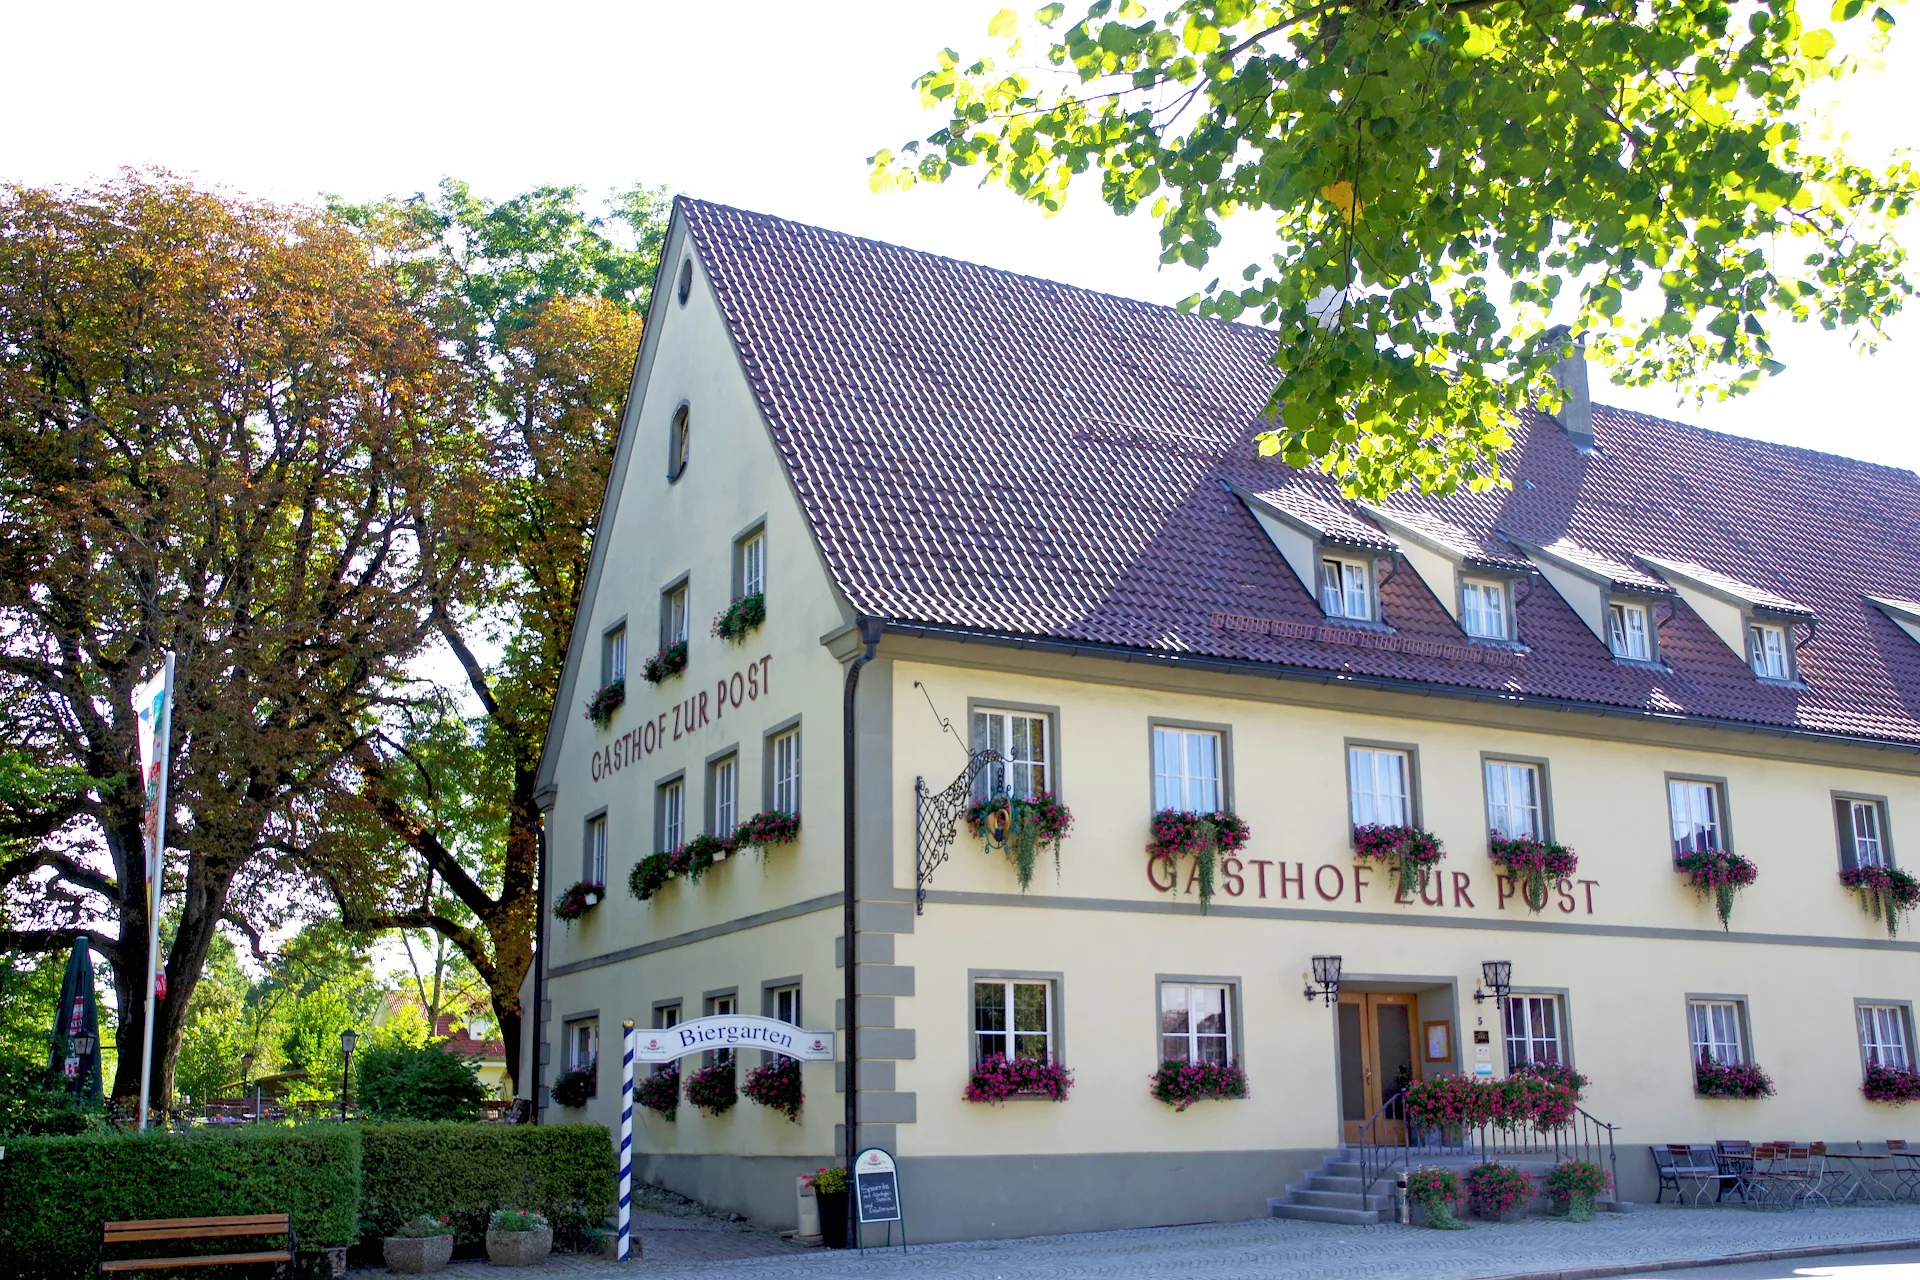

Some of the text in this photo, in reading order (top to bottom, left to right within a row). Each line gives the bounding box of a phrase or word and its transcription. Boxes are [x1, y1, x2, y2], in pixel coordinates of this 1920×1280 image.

[591, 654, 772, 783] GASTHOF ZUR POST
[1496, 873, 1600, 915] POST
[678, 1025, 792, 1048] Biergarten
[1477, 1016, 1483, 1026] 5
